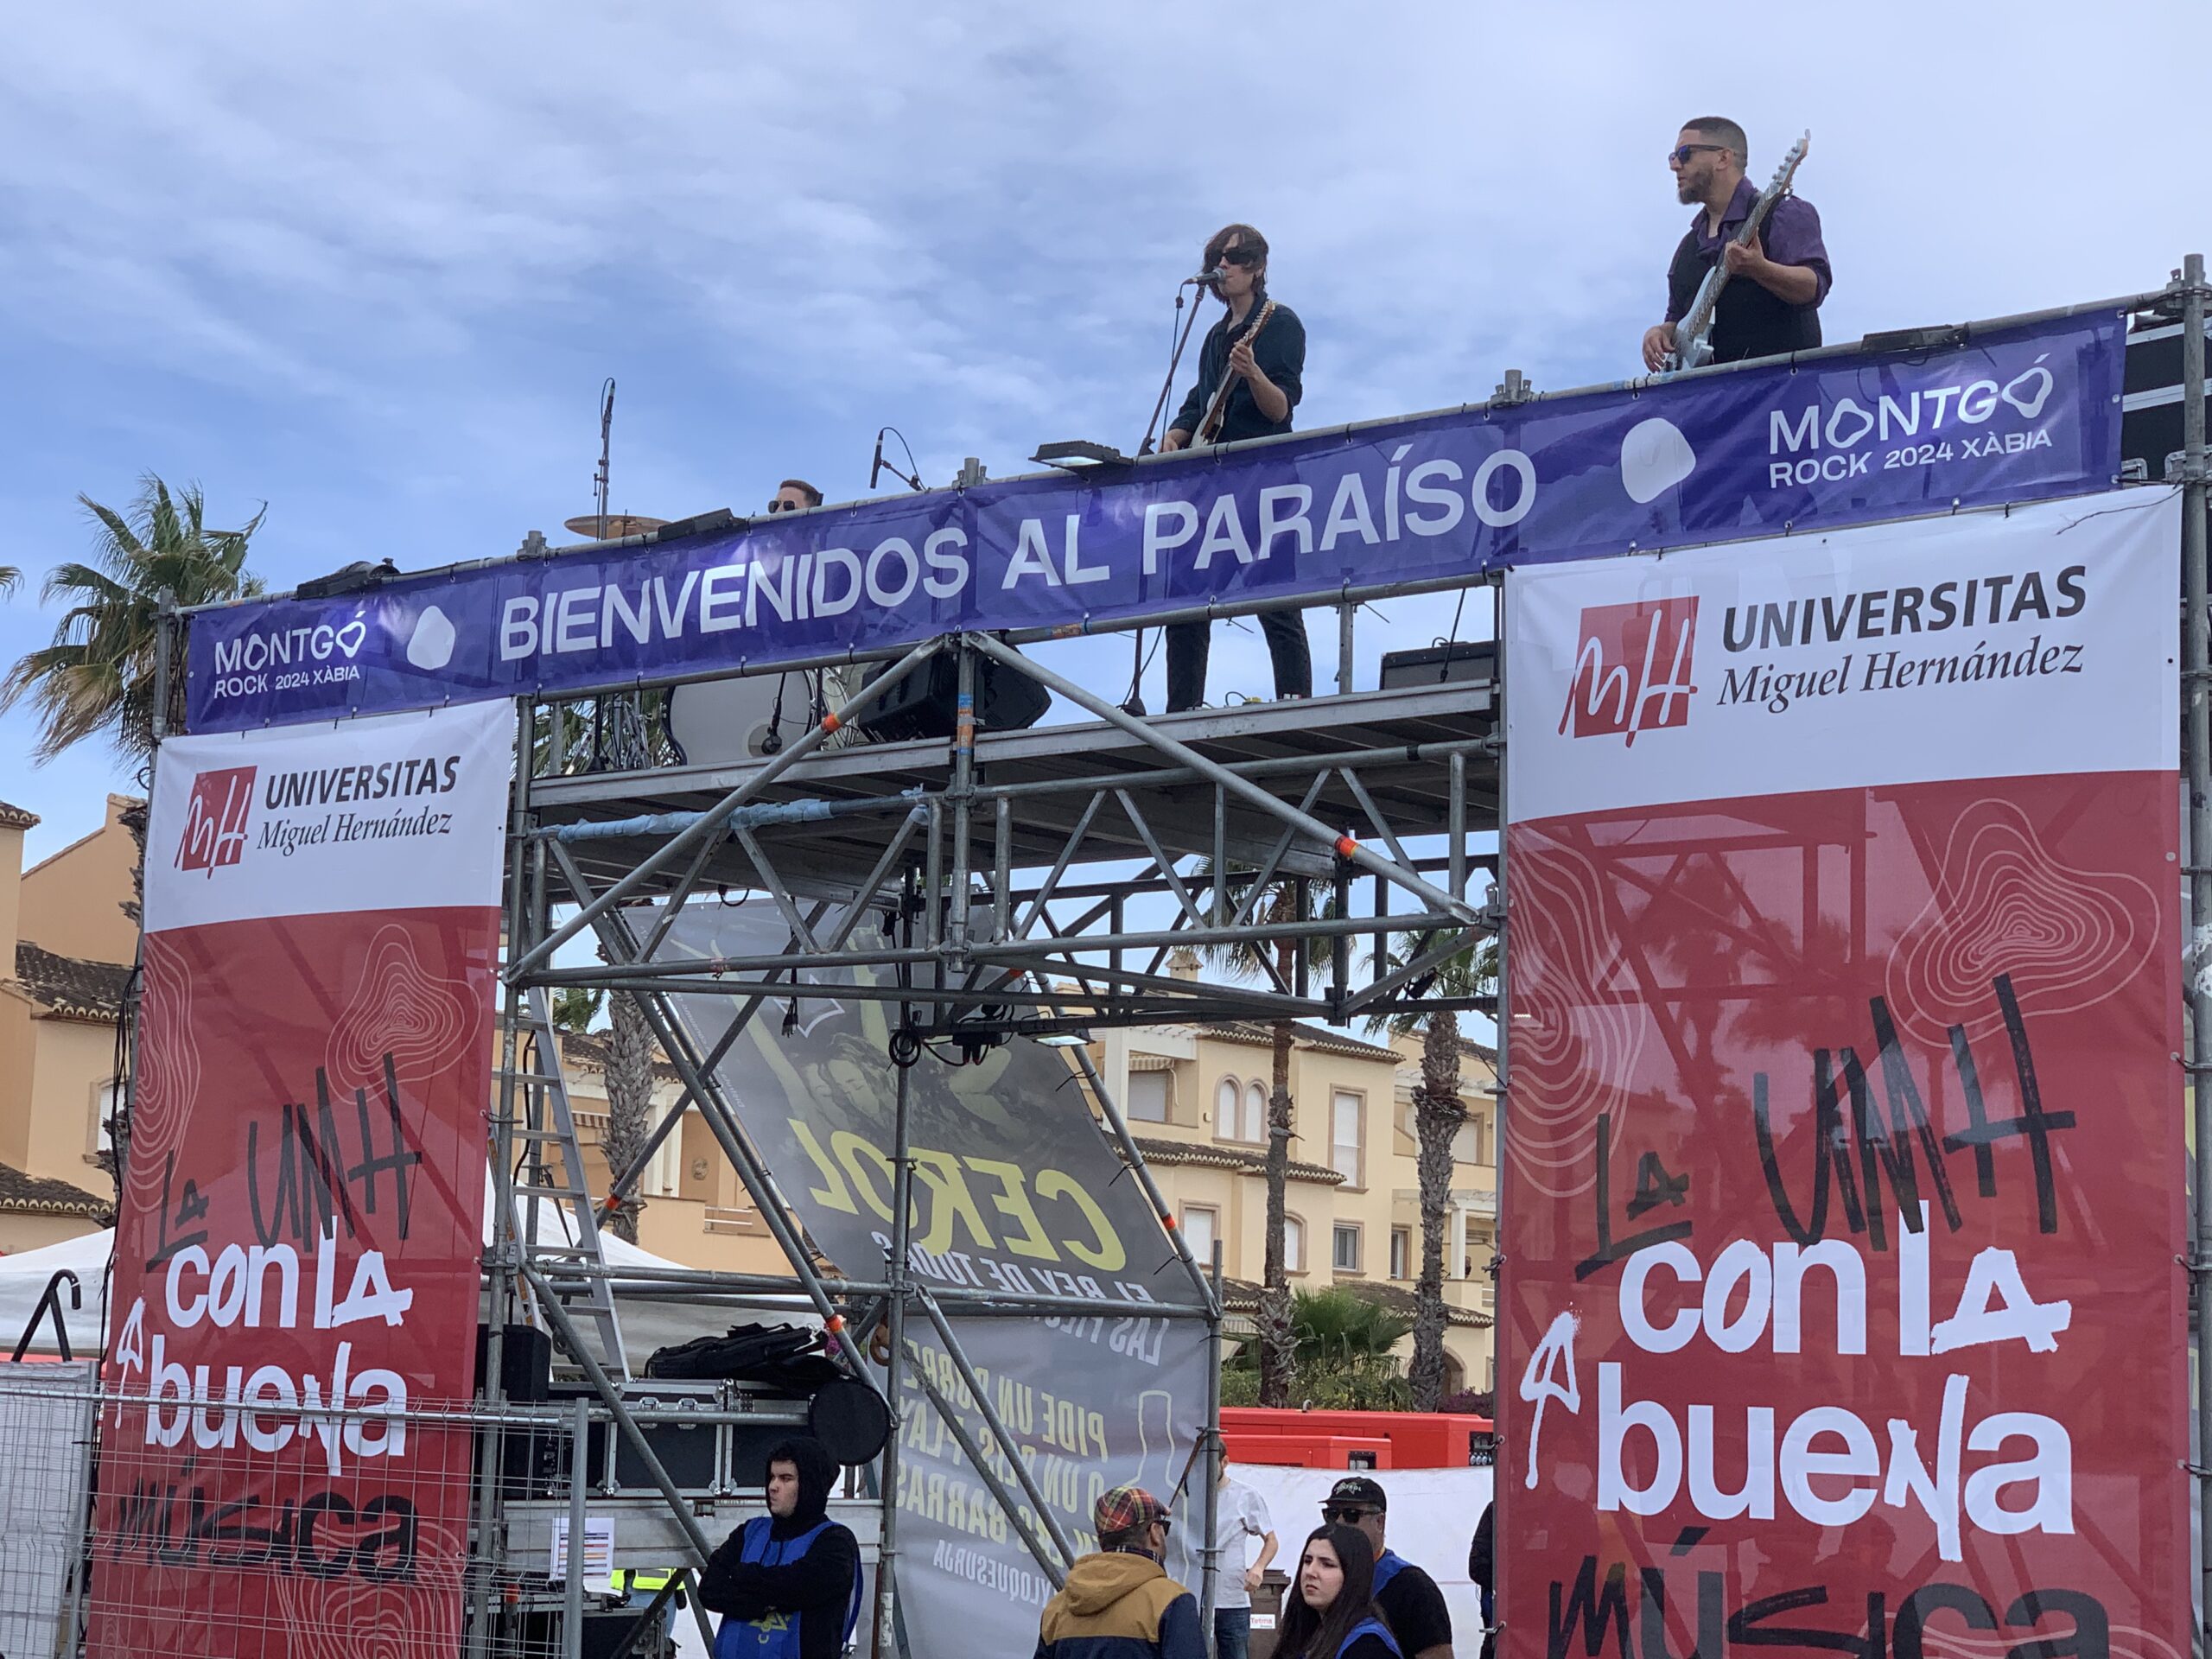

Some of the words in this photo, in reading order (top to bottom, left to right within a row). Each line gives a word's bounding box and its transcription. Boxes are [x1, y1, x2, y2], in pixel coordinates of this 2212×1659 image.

[1770, 353, 2054, 455] MONTGÓ
[1770, 450, 1872, 488] ROCK
[1884, 442, 1954, 470] 2024
[1961, 429, 2053, 460] XÀBIA
[500, 527, 969, 661] BIENVENIDOS
[1001, 514, 1111, 589] AL
[1142, 443, 1537, 575] PARAÍSO
[215, 610, 366, 675] MONTGÓ
[1722, 565, 2087, 652] UNIVERSITAS
[214, 673, 269, 698] ROCK
[275, 671, 310, 690] 2024
[313, 665, 360, 685] XÀBIA
[1717, 664, 1848, 714] Miguel
[1859, 634, 2085, 693] Hernández
[265, 755, 461, 810] UNIVERSITAS
[257, 815, 332, 857] Miguel
[332, 804, 454, 842] Hernández
[247, 1052, 423, 1253] UMH
[1753, 973, 2076, 1251] UMH
[165, 1243, 300, 1329] con
[1619, 1238, 1866, 1355] con
